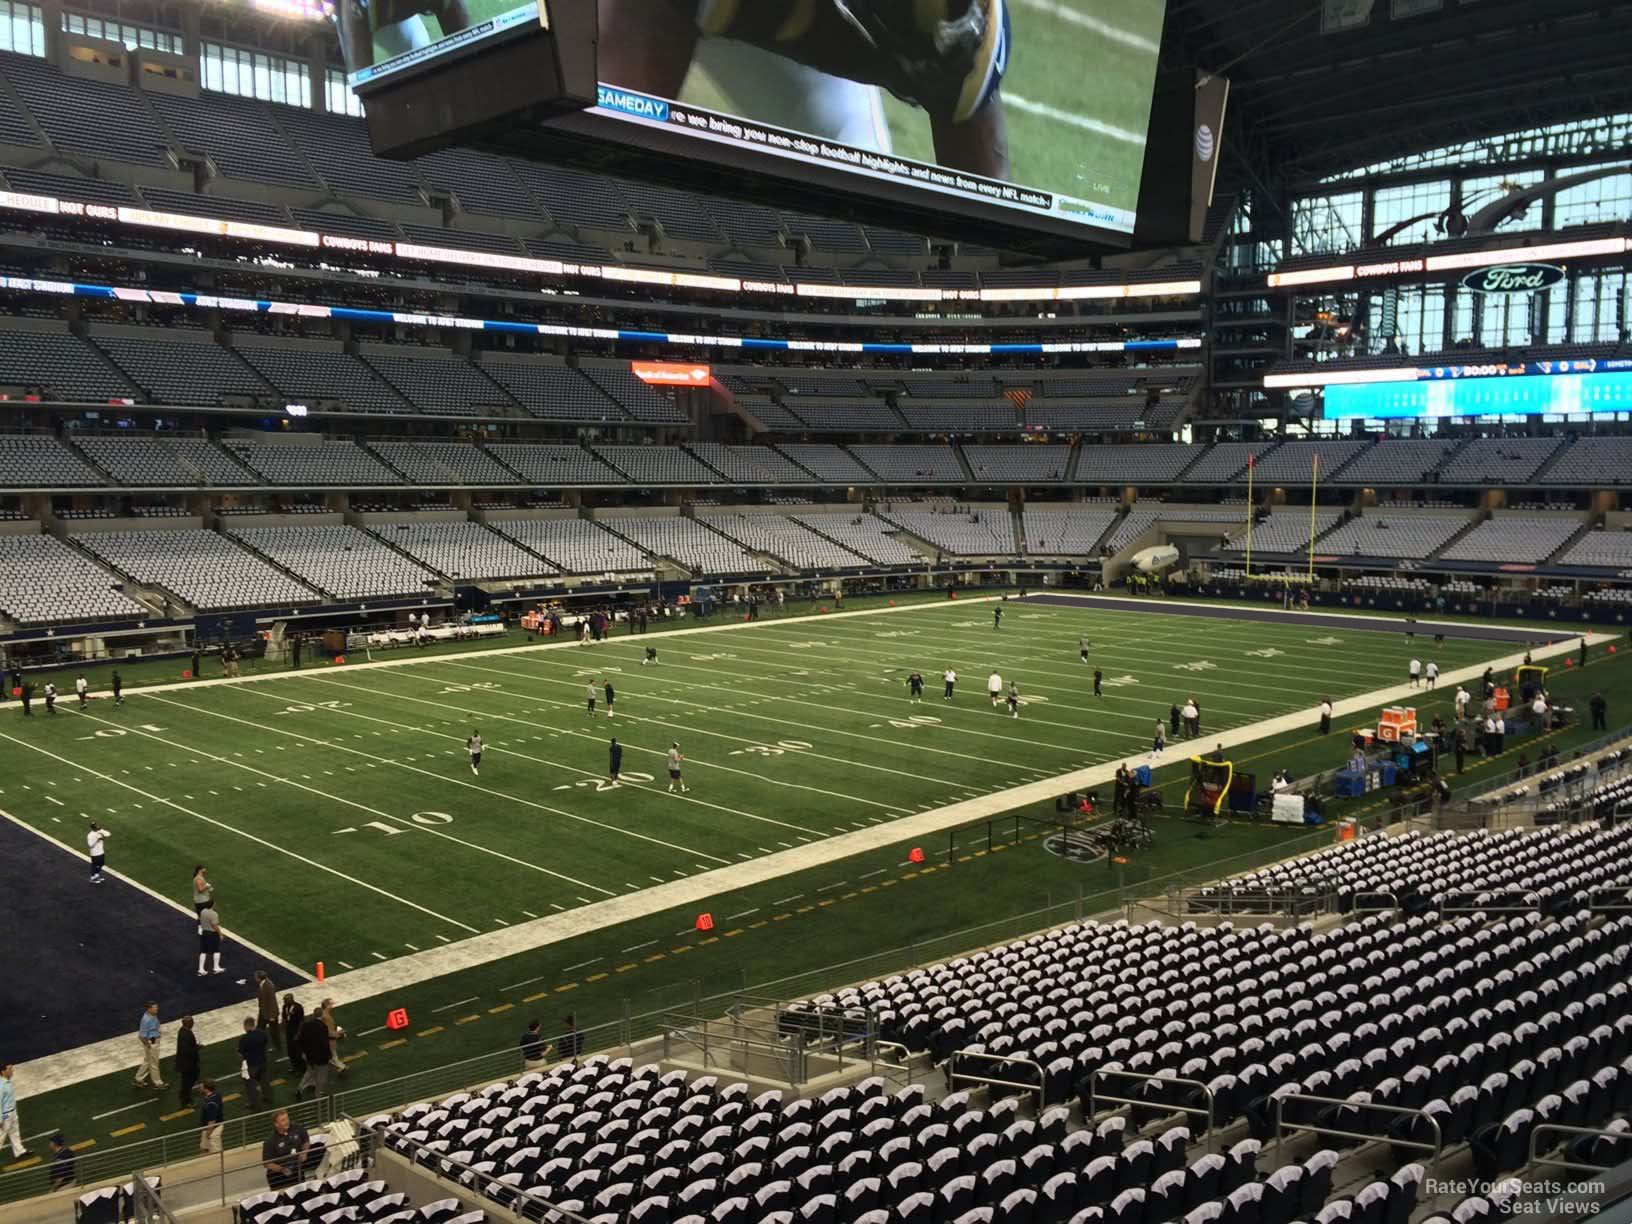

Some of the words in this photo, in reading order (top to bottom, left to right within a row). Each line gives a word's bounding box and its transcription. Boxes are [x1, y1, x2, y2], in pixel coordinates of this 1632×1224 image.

[709, 116, 742, 138] bring
[744, 127, 767, 141] you
[767, 133, 819, 155] non-stop
[820, 143, 861, 163] football
[862, 153, 910, 175] highlights
[911, 167, 930, 179] and
[930, 171, 955, 186] news
[956, 176, 978, 191] from
[978, 183, 1001, 198] every
[1002, 187, 1019, 200] NFL
[1482, 267, 1545, 290] Ford
[575, 771, 656, 792] 20
[361, 811, 455, 837] 10
[394, 1010, 406, 1027] G
